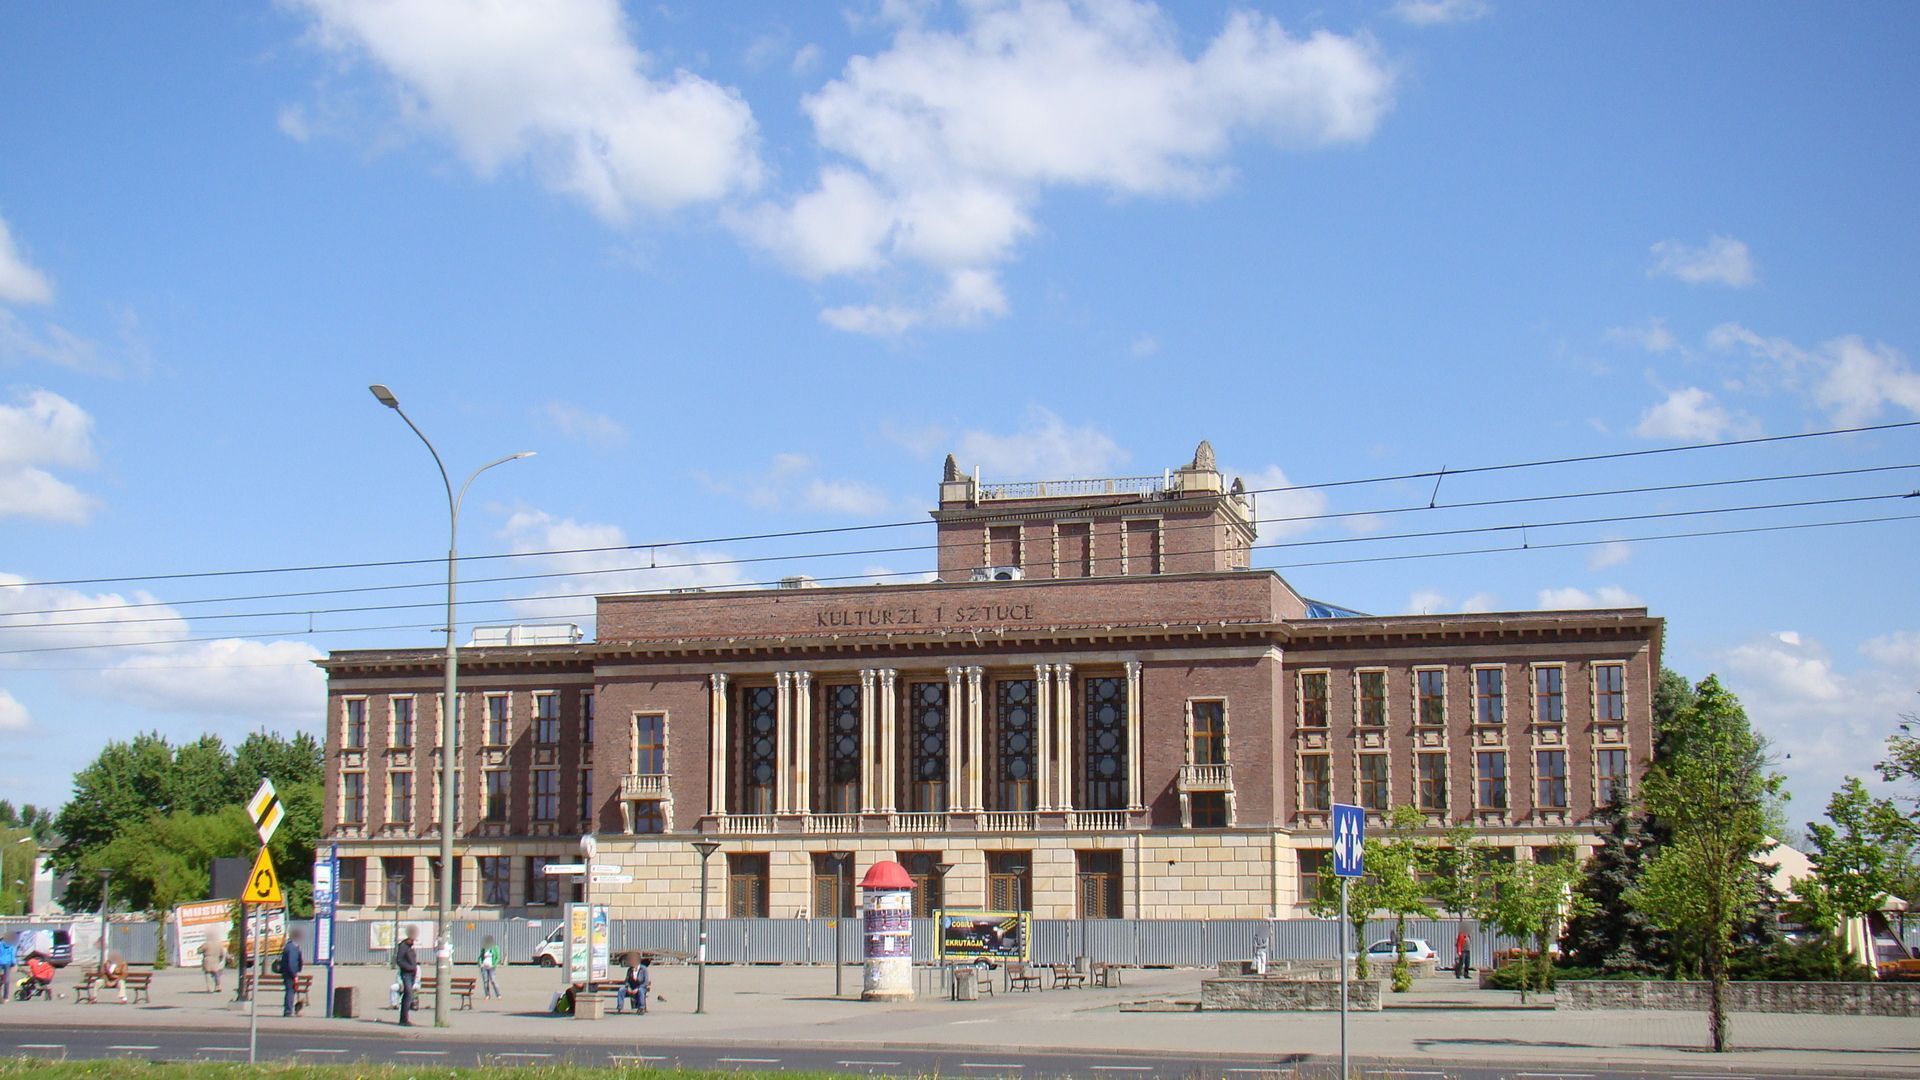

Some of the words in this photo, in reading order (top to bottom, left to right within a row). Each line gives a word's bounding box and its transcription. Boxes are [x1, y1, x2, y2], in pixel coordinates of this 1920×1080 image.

[817, 607, 922, 627] KULTURZE
[935, 606, 943, 622] I
[955, 604, 1034, 623] SZTUCE
